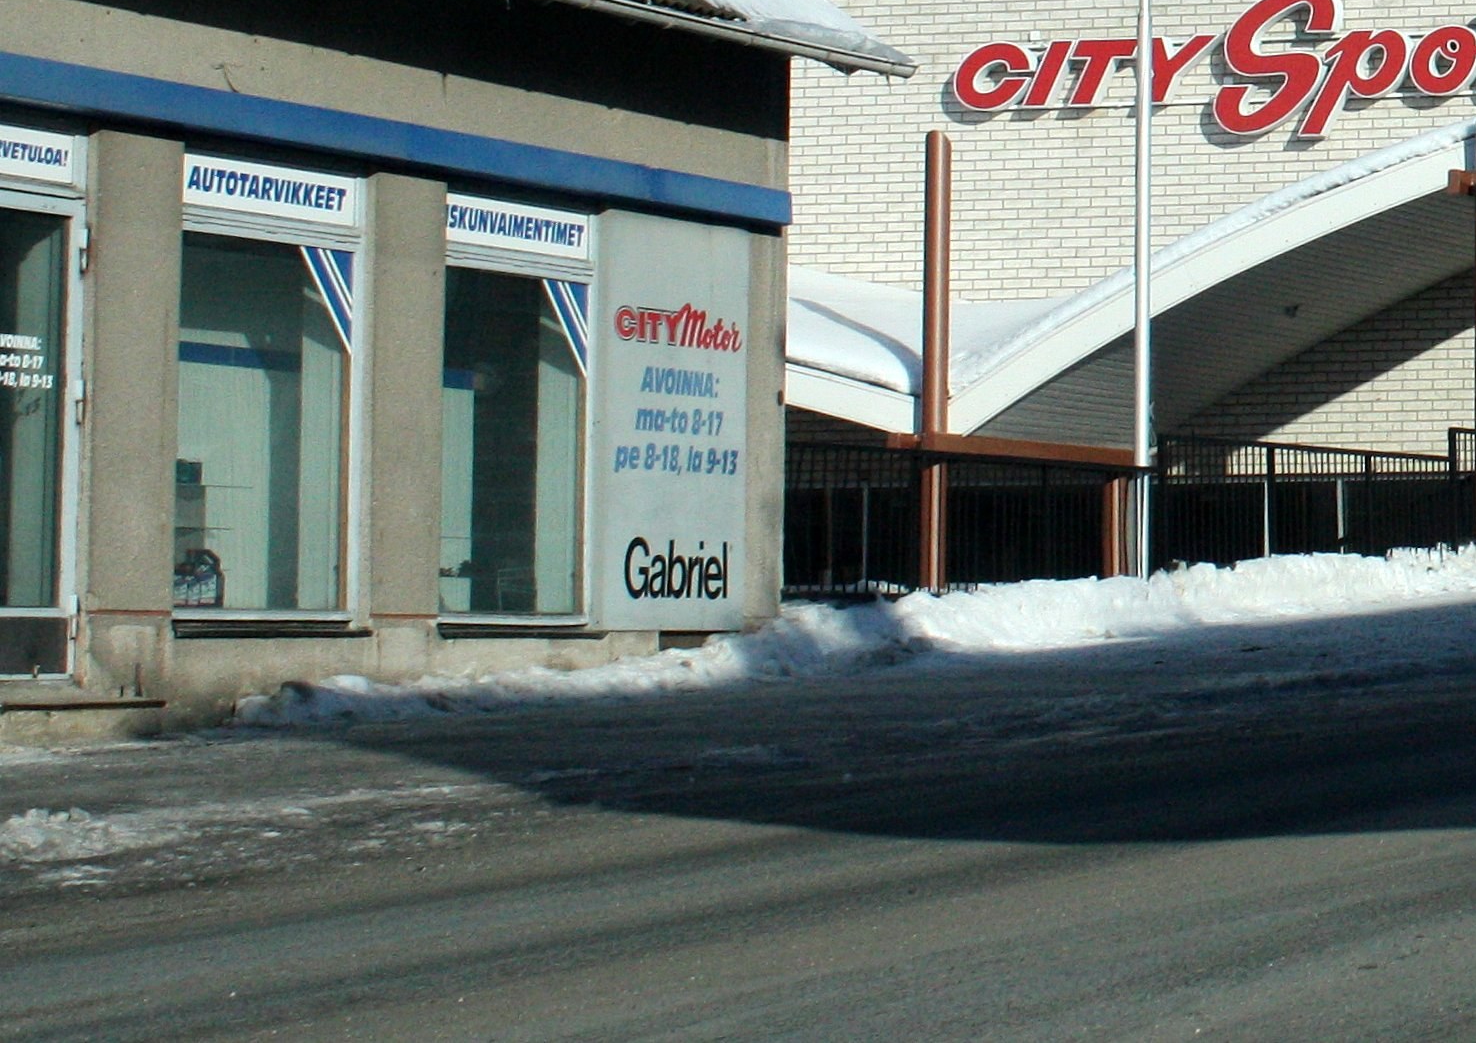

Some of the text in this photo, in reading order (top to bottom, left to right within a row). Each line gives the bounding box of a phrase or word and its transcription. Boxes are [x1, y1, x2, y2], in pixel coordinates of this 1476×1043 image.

[952, 33, 1218, 112] CITY
[187, 165, 347, 212] AUTOTARVIKKEET
[0, 333, 42, 350] VOINNA:
[614, 302, 743, 353] CITY Motor
[640, 366, 720, 398] AVOINNA:
[635, 407, 724, 436] ma-to 8-17
[614, 443, 739, 476] pe 8-18, la 9-13
[624, 536, 728, 600] Gabriel
